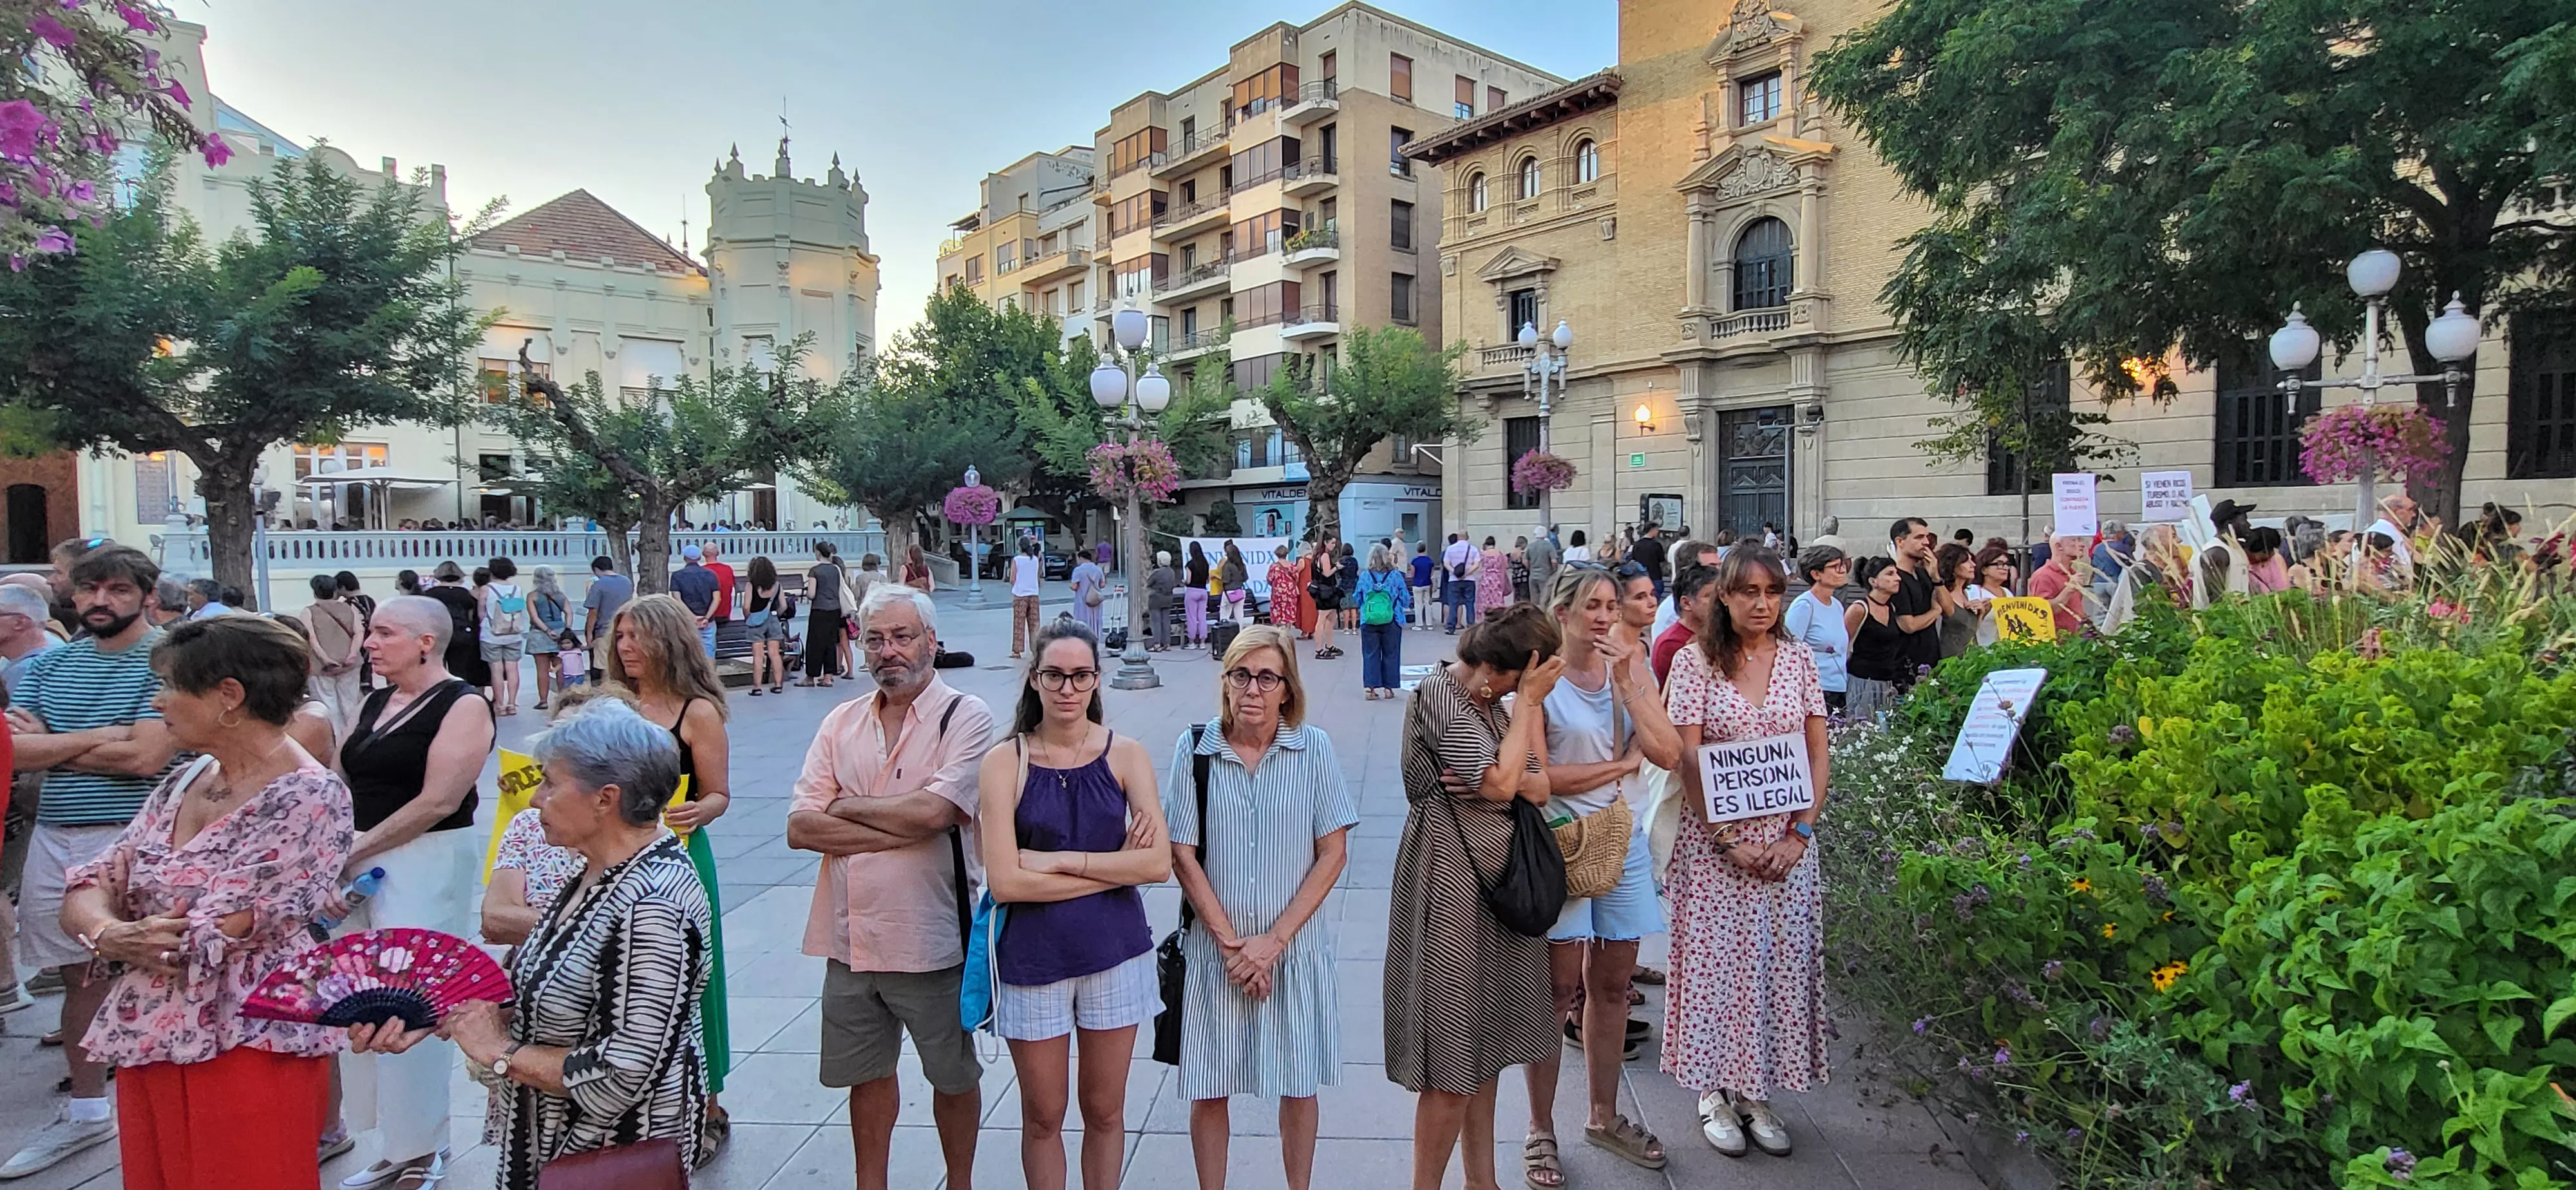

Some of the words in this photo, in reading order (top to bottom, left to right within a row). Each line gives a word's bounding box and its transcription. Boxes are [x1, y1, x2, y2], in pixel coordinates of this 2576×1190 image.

[1709, 741, 1795, 770] NINGUNA
[1713, 762, 1802, 792] PERSONA
[1713, 795, 1740, 815] ES
[1746, 784, 1811, 811] ILEGAL
